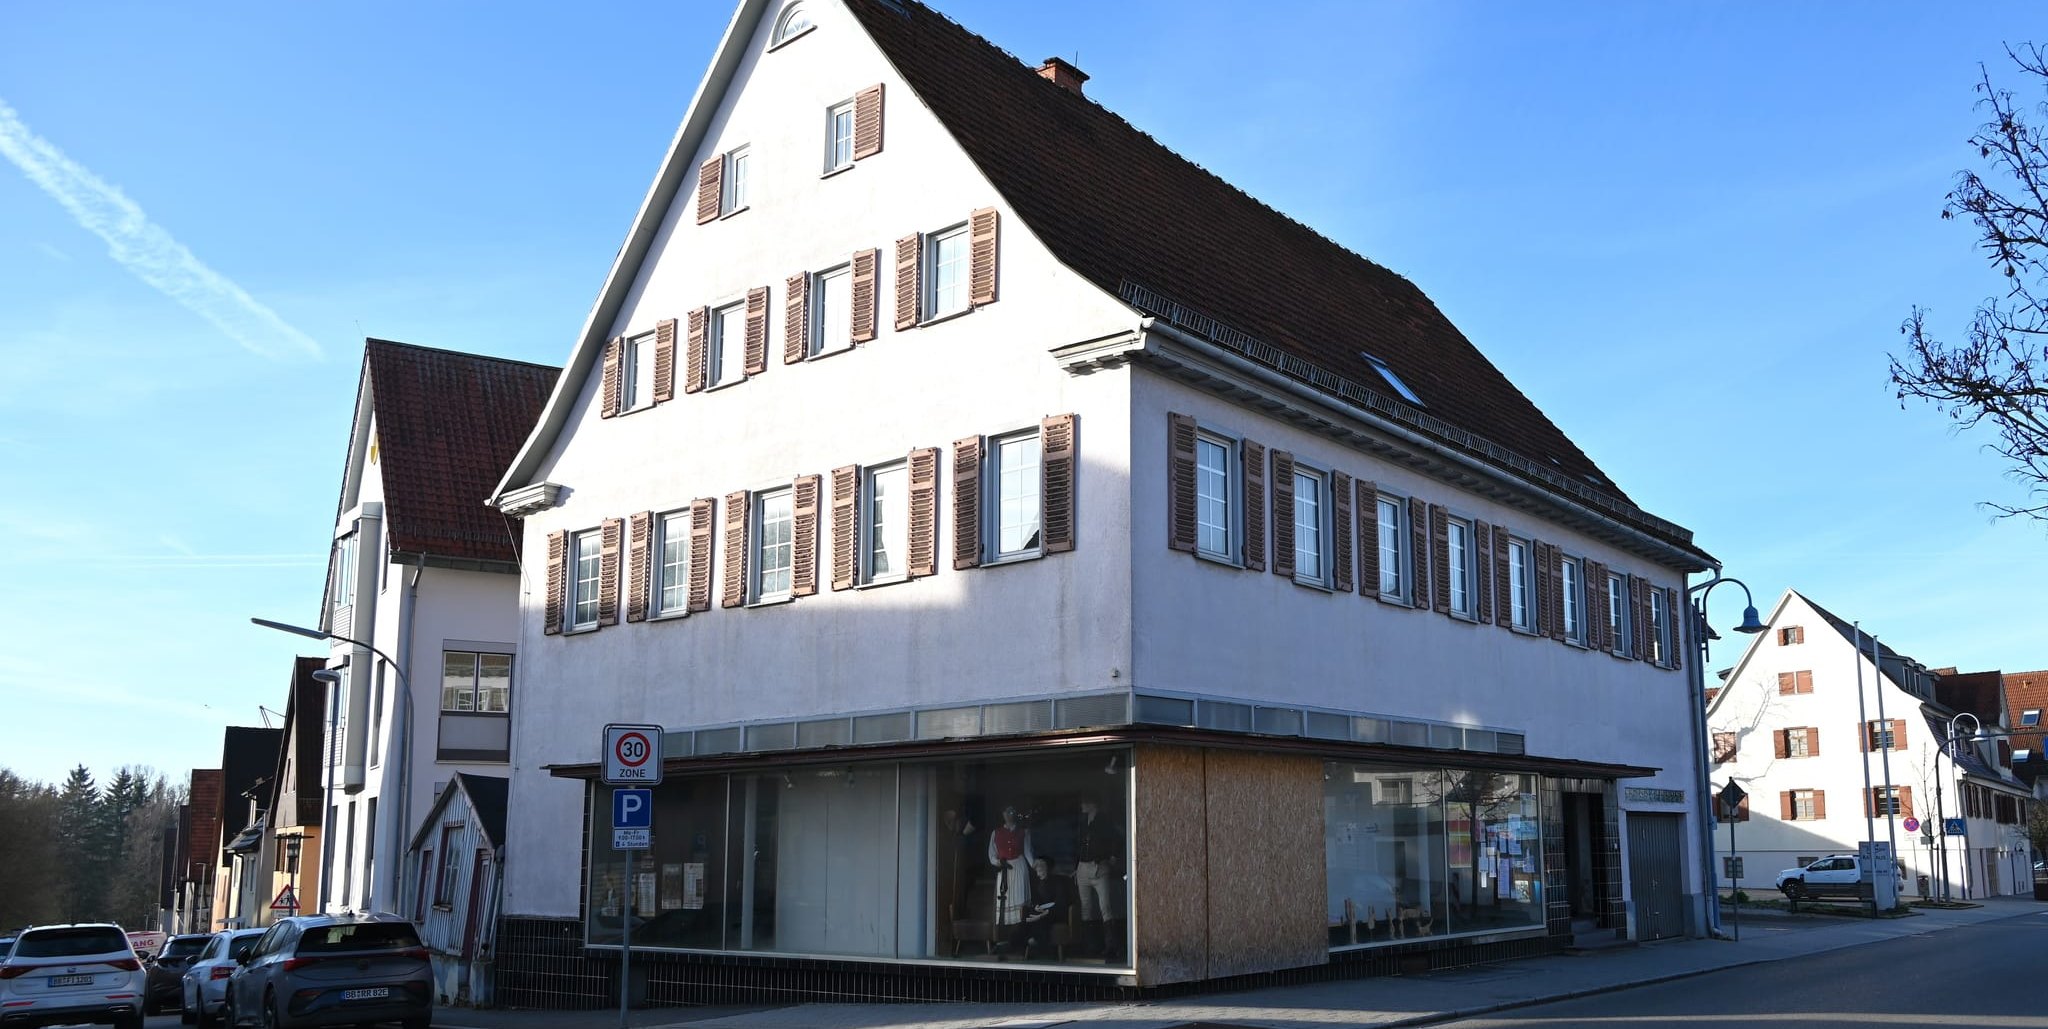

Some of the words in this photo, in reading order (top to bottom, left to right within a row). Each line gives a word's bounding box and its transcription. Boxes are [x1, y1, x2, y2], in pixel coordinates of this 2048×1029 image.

[623, 741, 643, 757] 30
[620, 769, 646, 777] ZONE
[622, 795, 642, 822] P
